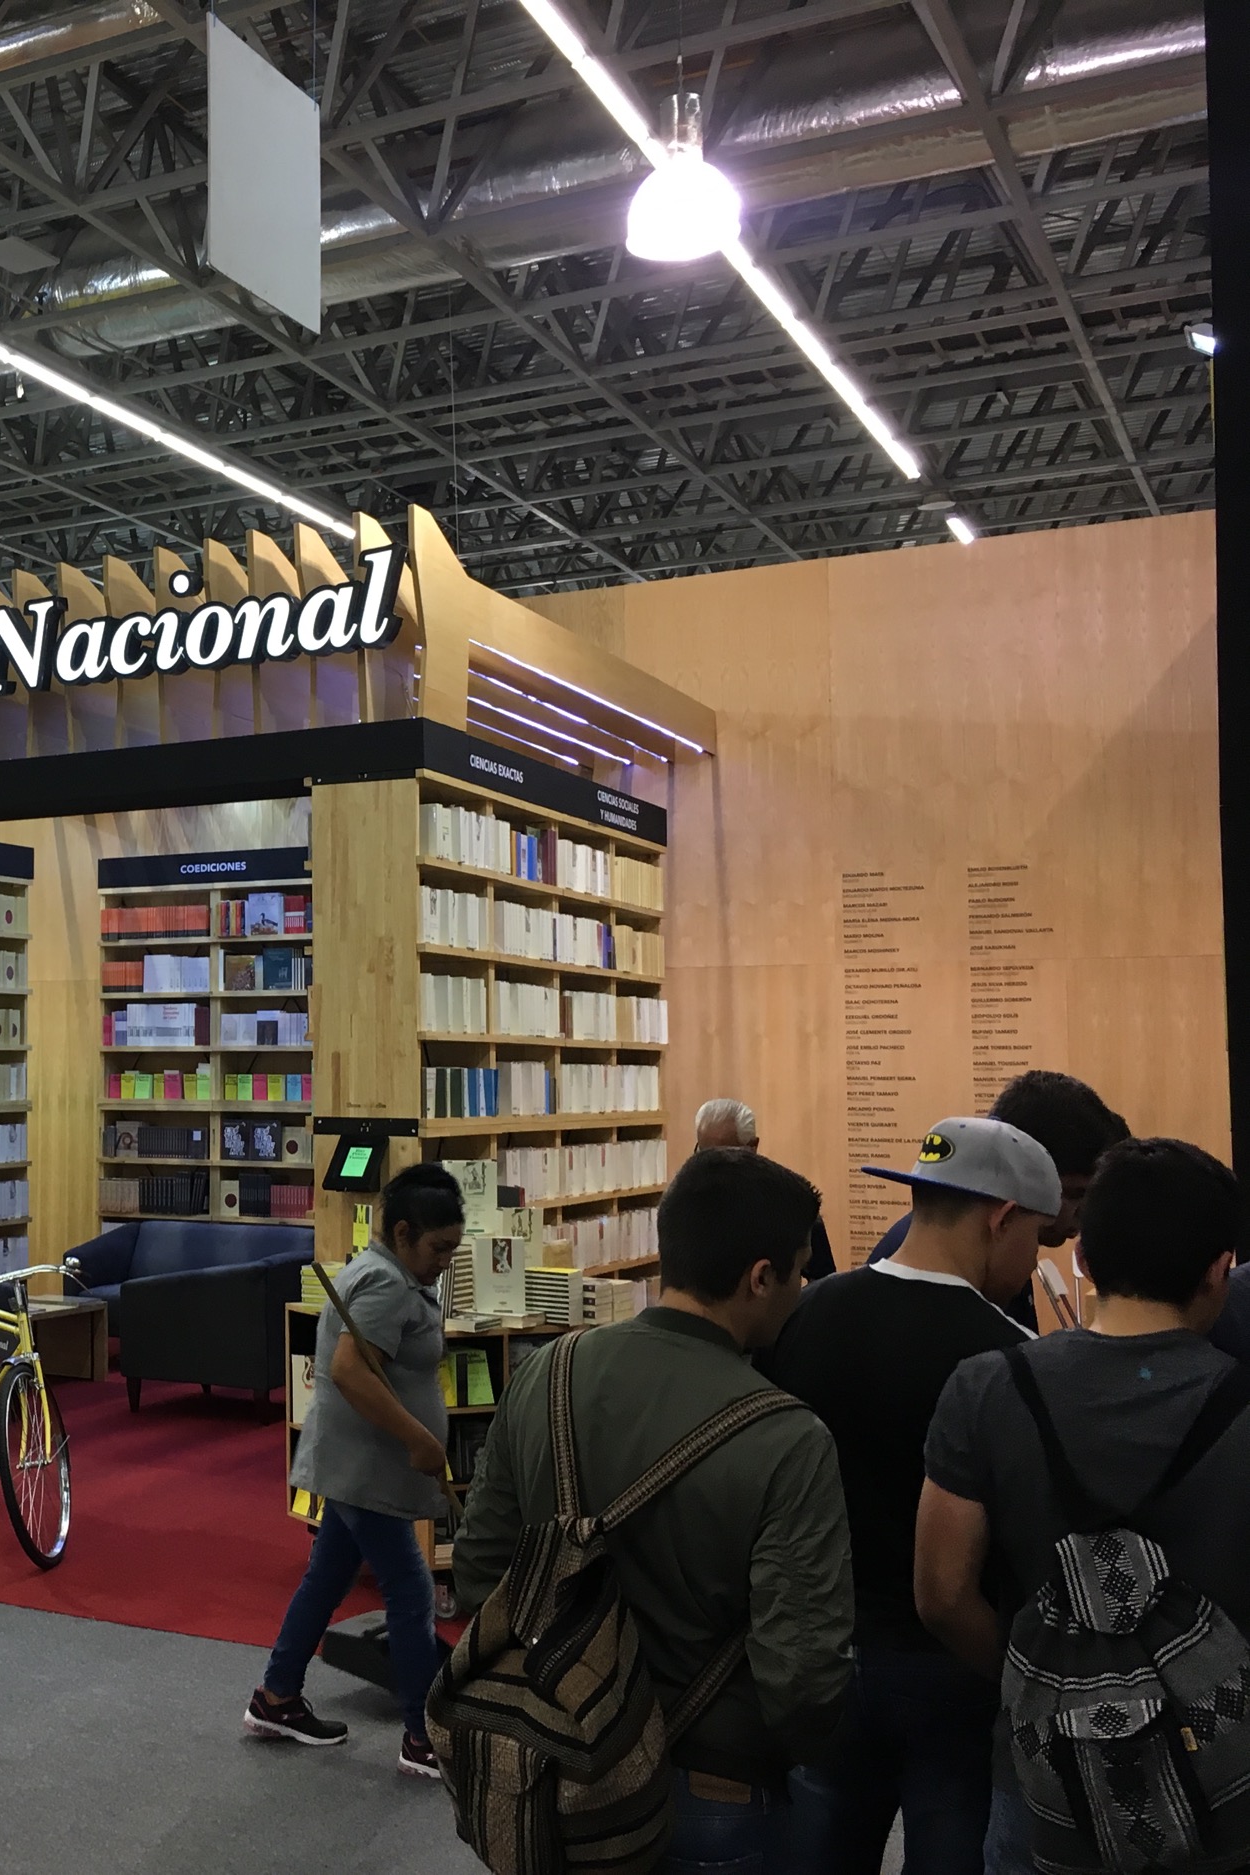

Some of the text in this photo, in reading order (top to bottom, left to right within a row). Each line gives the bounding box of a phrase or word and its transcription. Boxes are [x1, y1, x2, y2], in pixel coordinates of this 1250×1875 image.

[469, 754, 524, 784] CIENCIAS EXACTAS
[597, 790, 639, 815] CIENCIAS SOCIALES
[600, 808, 637, 831] Y HUMANIDADES
[180, 861, 247, 874] COEDICIONES
